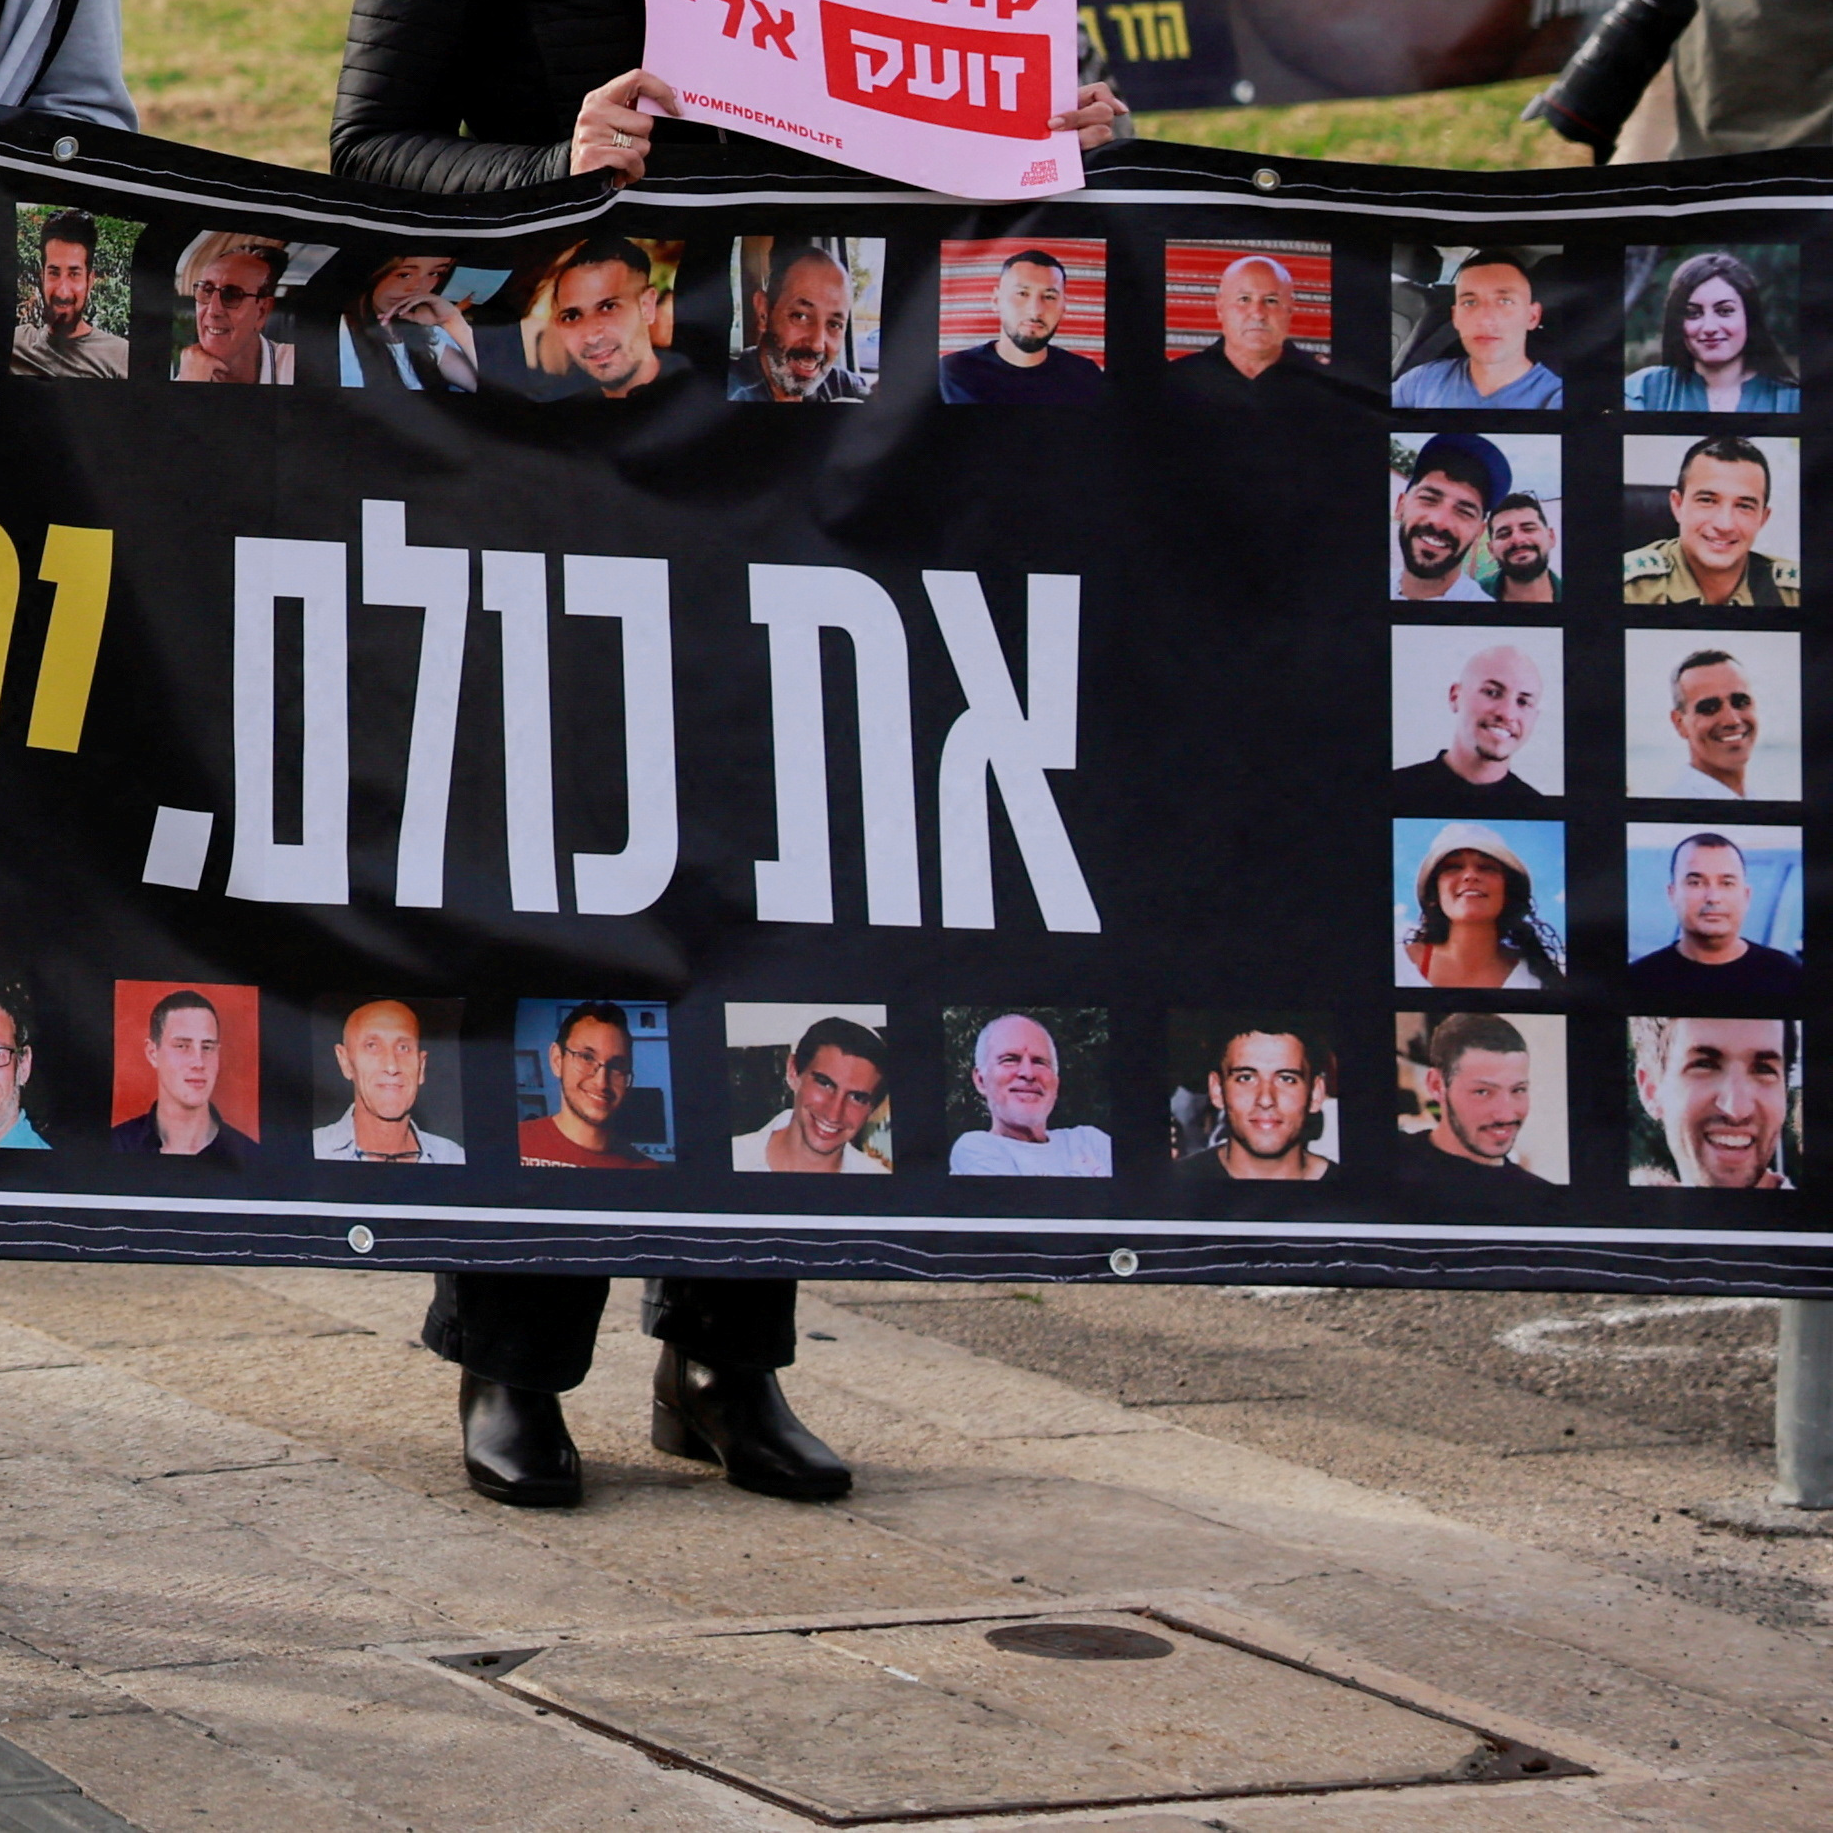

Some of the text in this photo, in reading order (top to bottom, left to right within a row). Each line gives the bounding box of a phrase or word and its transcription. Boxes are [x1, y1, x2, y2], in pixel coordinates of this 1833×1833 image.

[849, 28, 1026, 113] זועק
[1107, 0, 1192, 63] הדר
[682, 90, 844, 150] WOMENDEMANDLIFE
[141, 499, 681, 916] כולם.
[747, 563, 1102, 935] את
